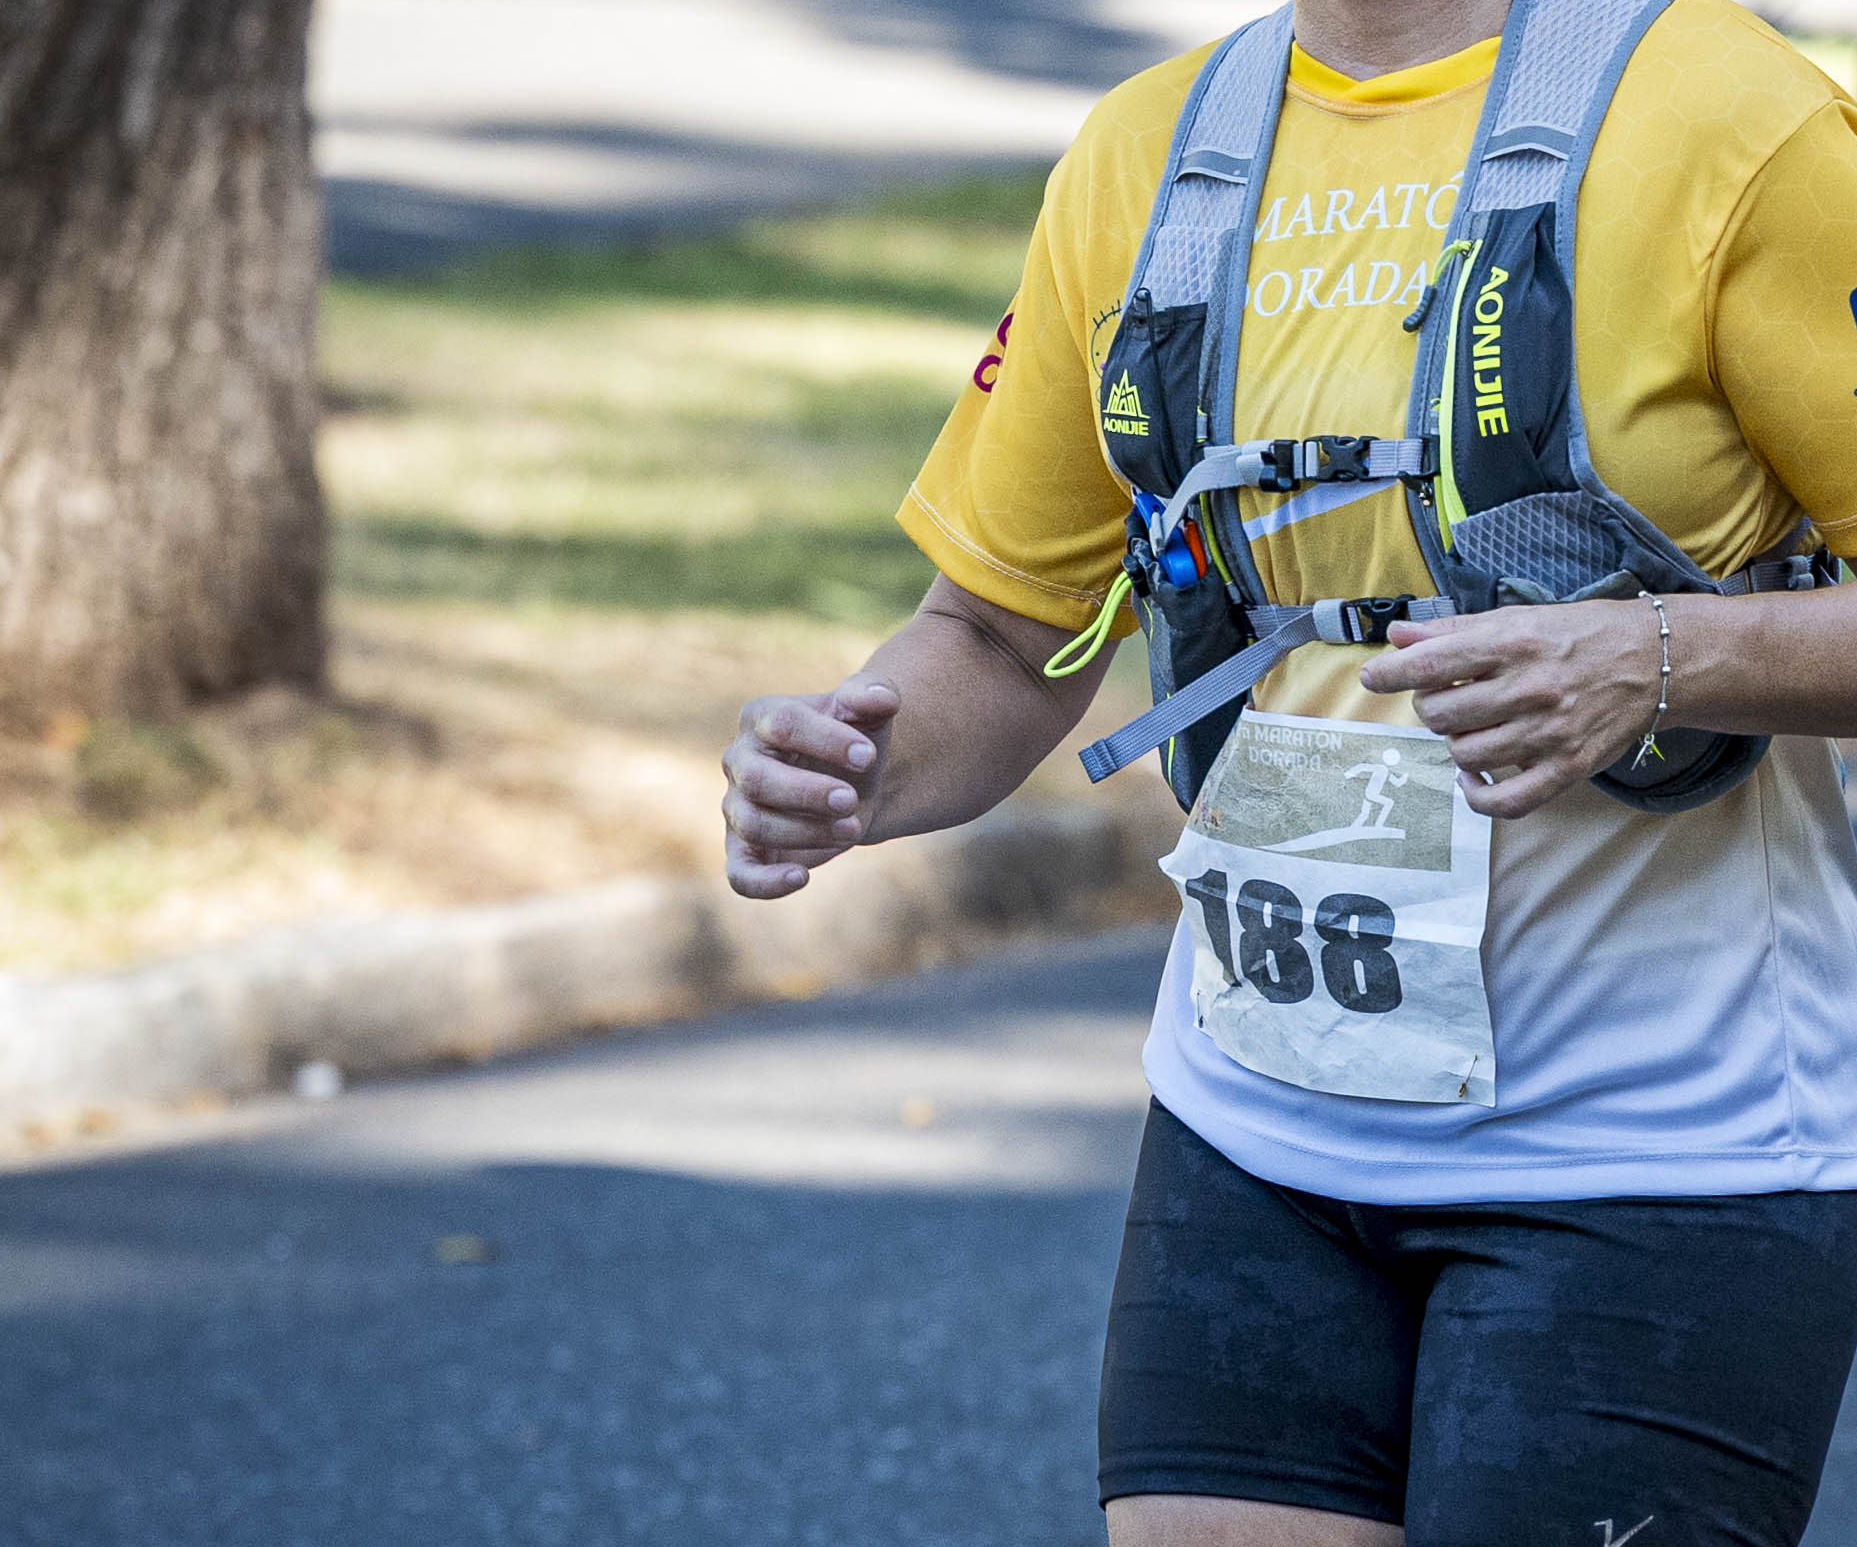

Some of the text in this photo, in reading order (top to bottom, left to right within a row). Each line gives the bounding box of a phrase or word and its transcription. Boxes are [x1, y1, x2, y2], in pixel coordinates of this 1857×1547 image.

[1244, 259, 1430, 318] ORADA
[1472, 265, 1510, 438] AONIJIE
[1103, 416, 1150, 437] AONIJIE
[1186, 868, 1403, 1014] 188
